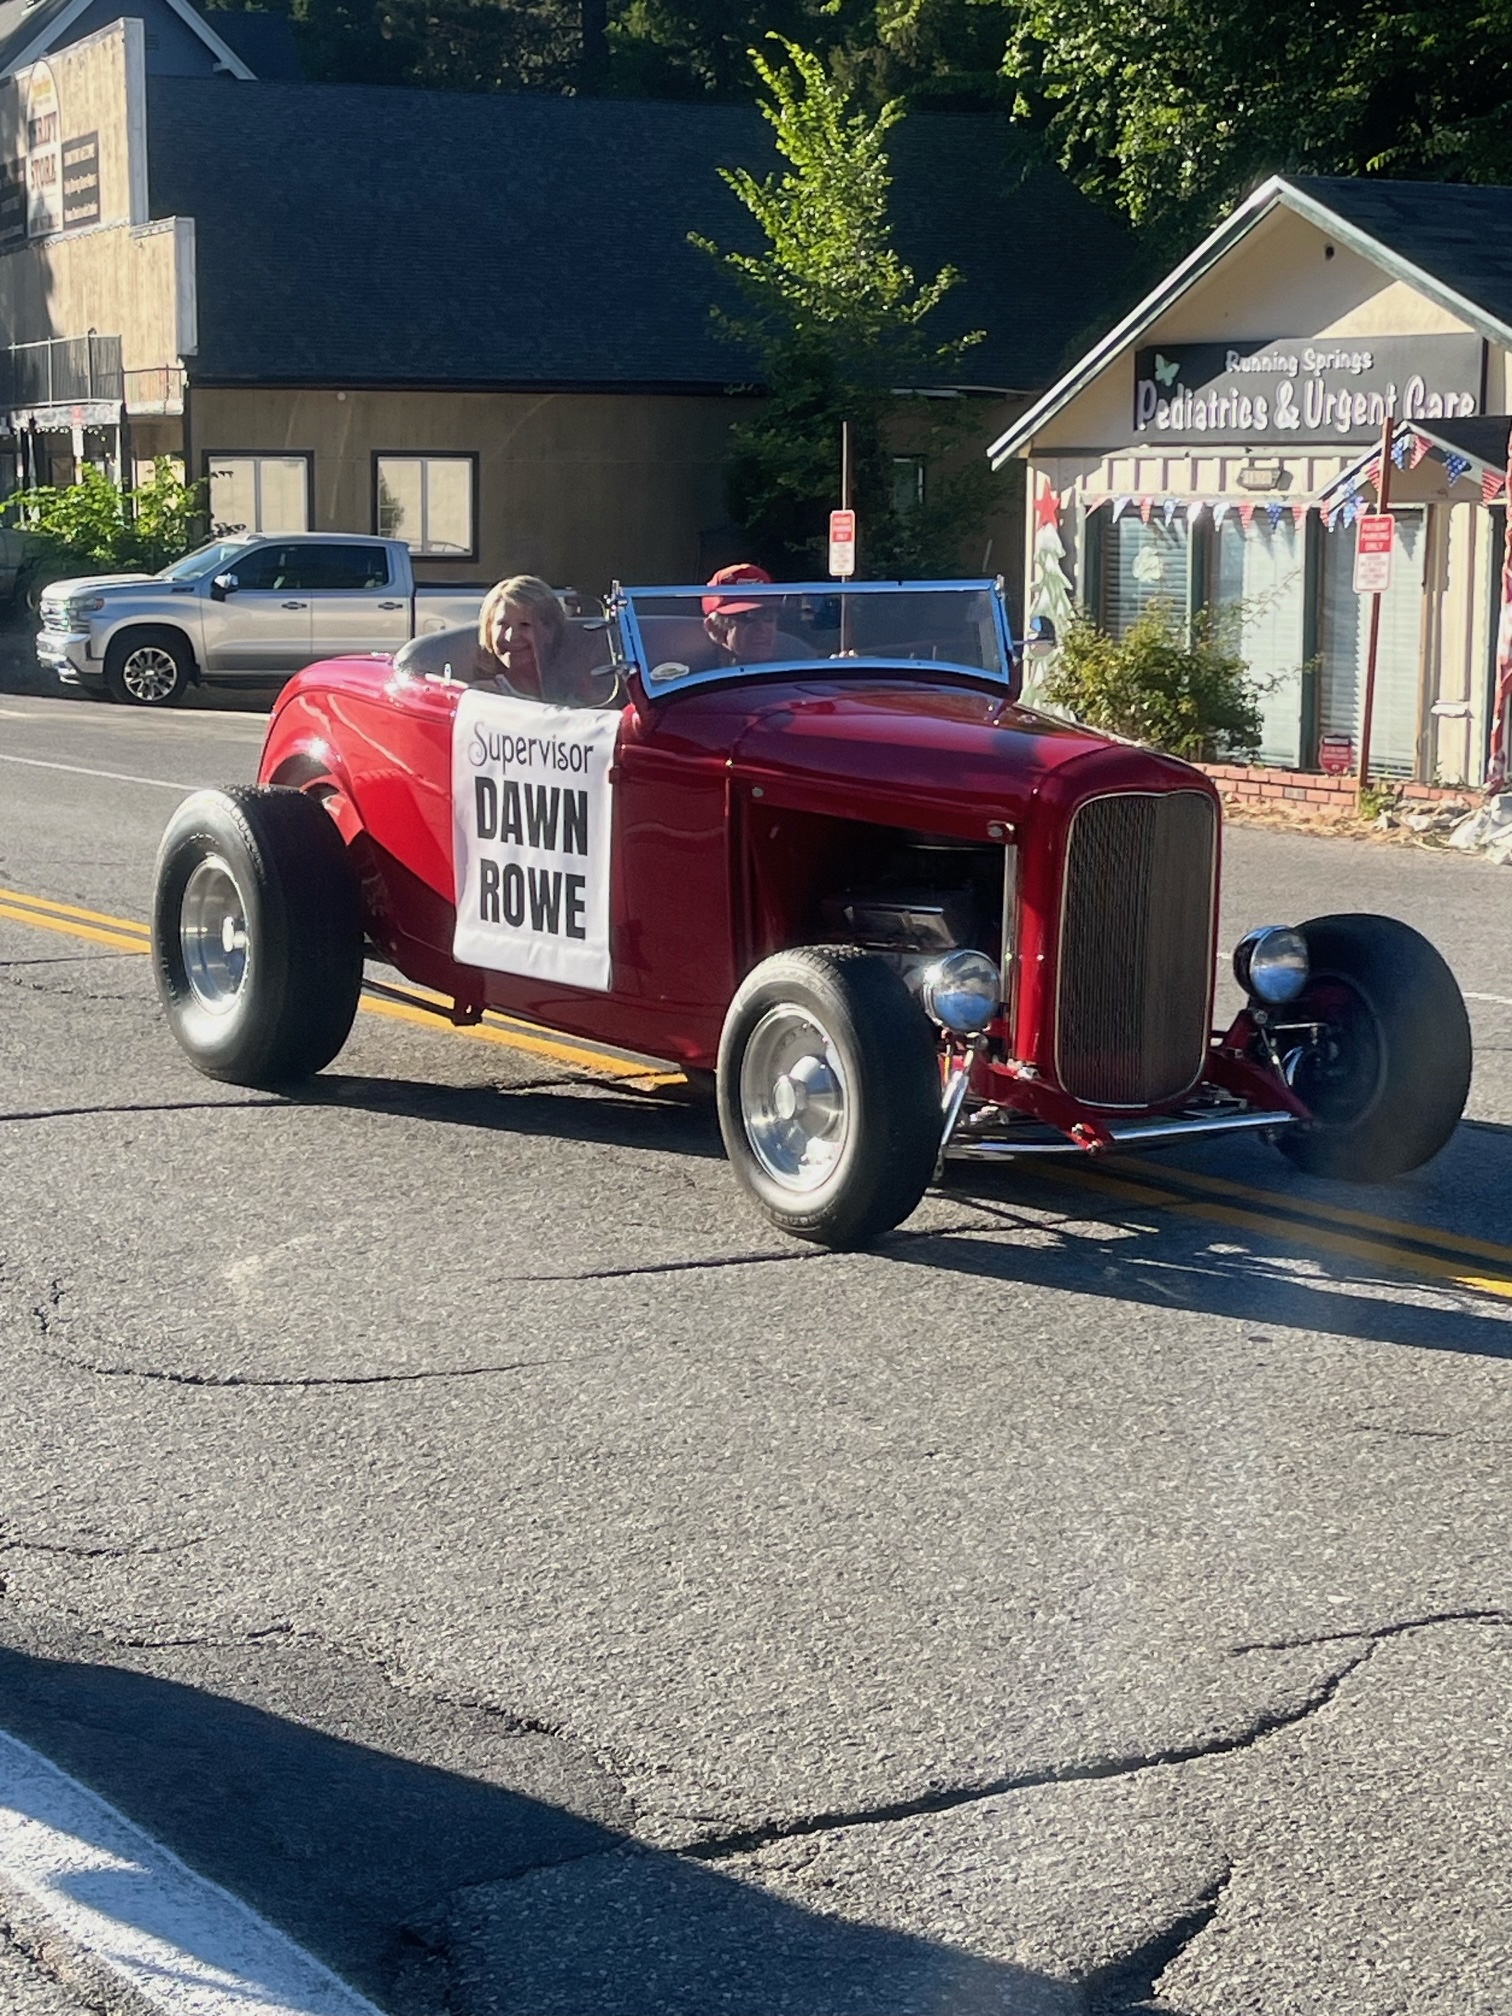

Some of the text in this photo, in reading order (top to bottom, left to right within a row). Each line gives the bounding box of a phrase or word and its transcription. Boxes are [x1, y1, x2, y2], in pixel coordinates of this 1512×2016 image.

[1226, 347, 1374, 378] Running Springs
[1137, 374, 1476, 433] Pediatrics & Urgent Care
[468, 721, 594, 774] Supervisor
[474, 776, 588, 857] DAWN
[480, 858, 586, 941] ROWE
